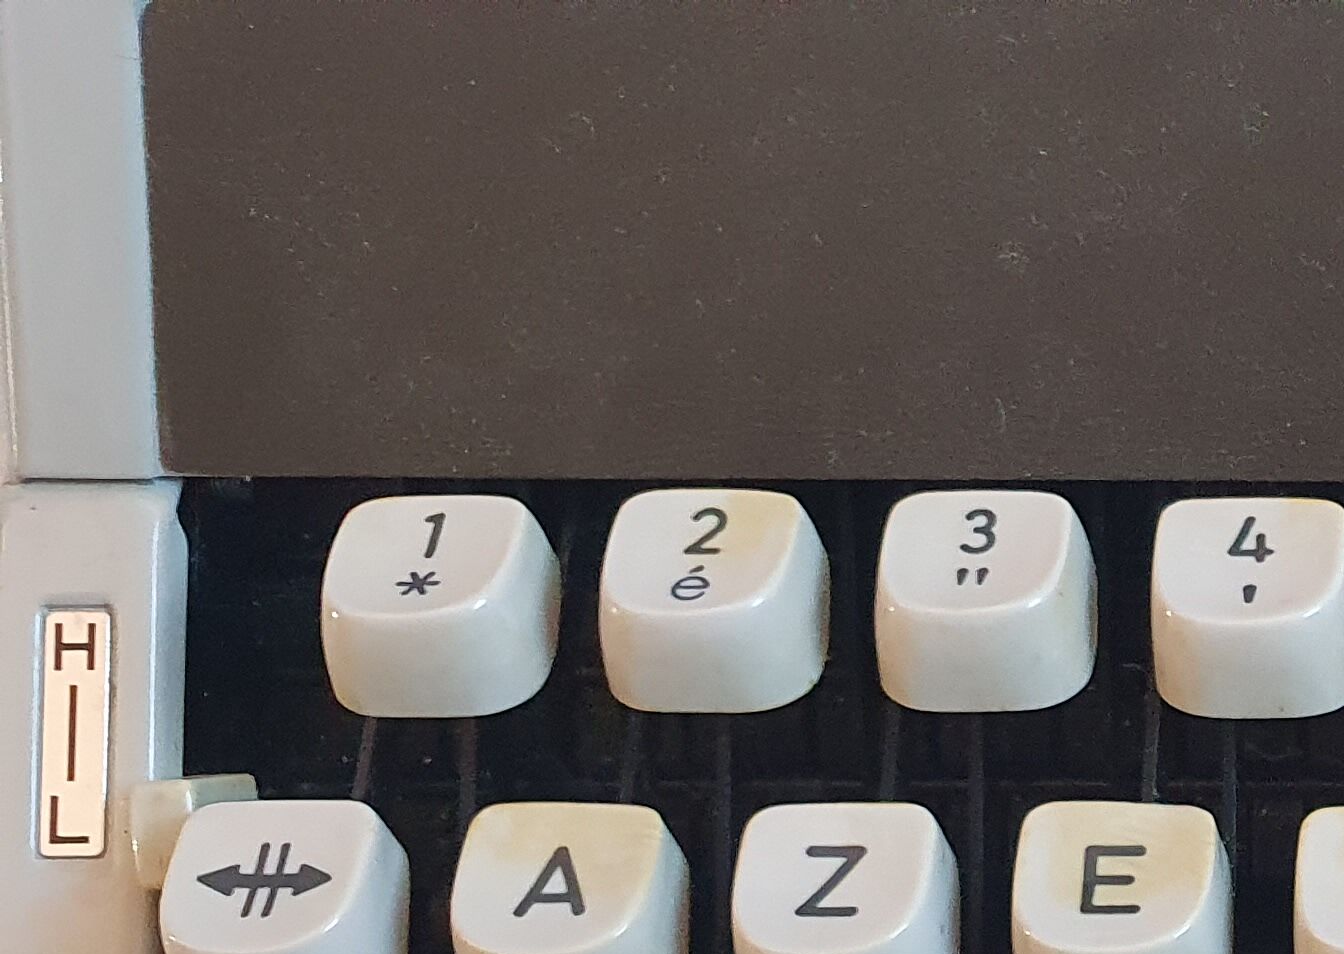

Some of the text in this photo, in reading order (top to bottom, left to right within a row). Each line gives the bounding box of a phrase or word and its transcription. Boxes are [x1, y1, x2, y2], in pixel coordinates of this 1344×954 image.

[422, 510, 448, 560] 1
[681, 505, 729, 557] 2
[958, 507, 999, 556] 3
[1225, 514, 1276, 565] 4
[669, 565, 712, 603] é
[511, 844, 587, 919] A
[792, 843, 869, 919] Z
[1078, 843, 1149, 916] E
